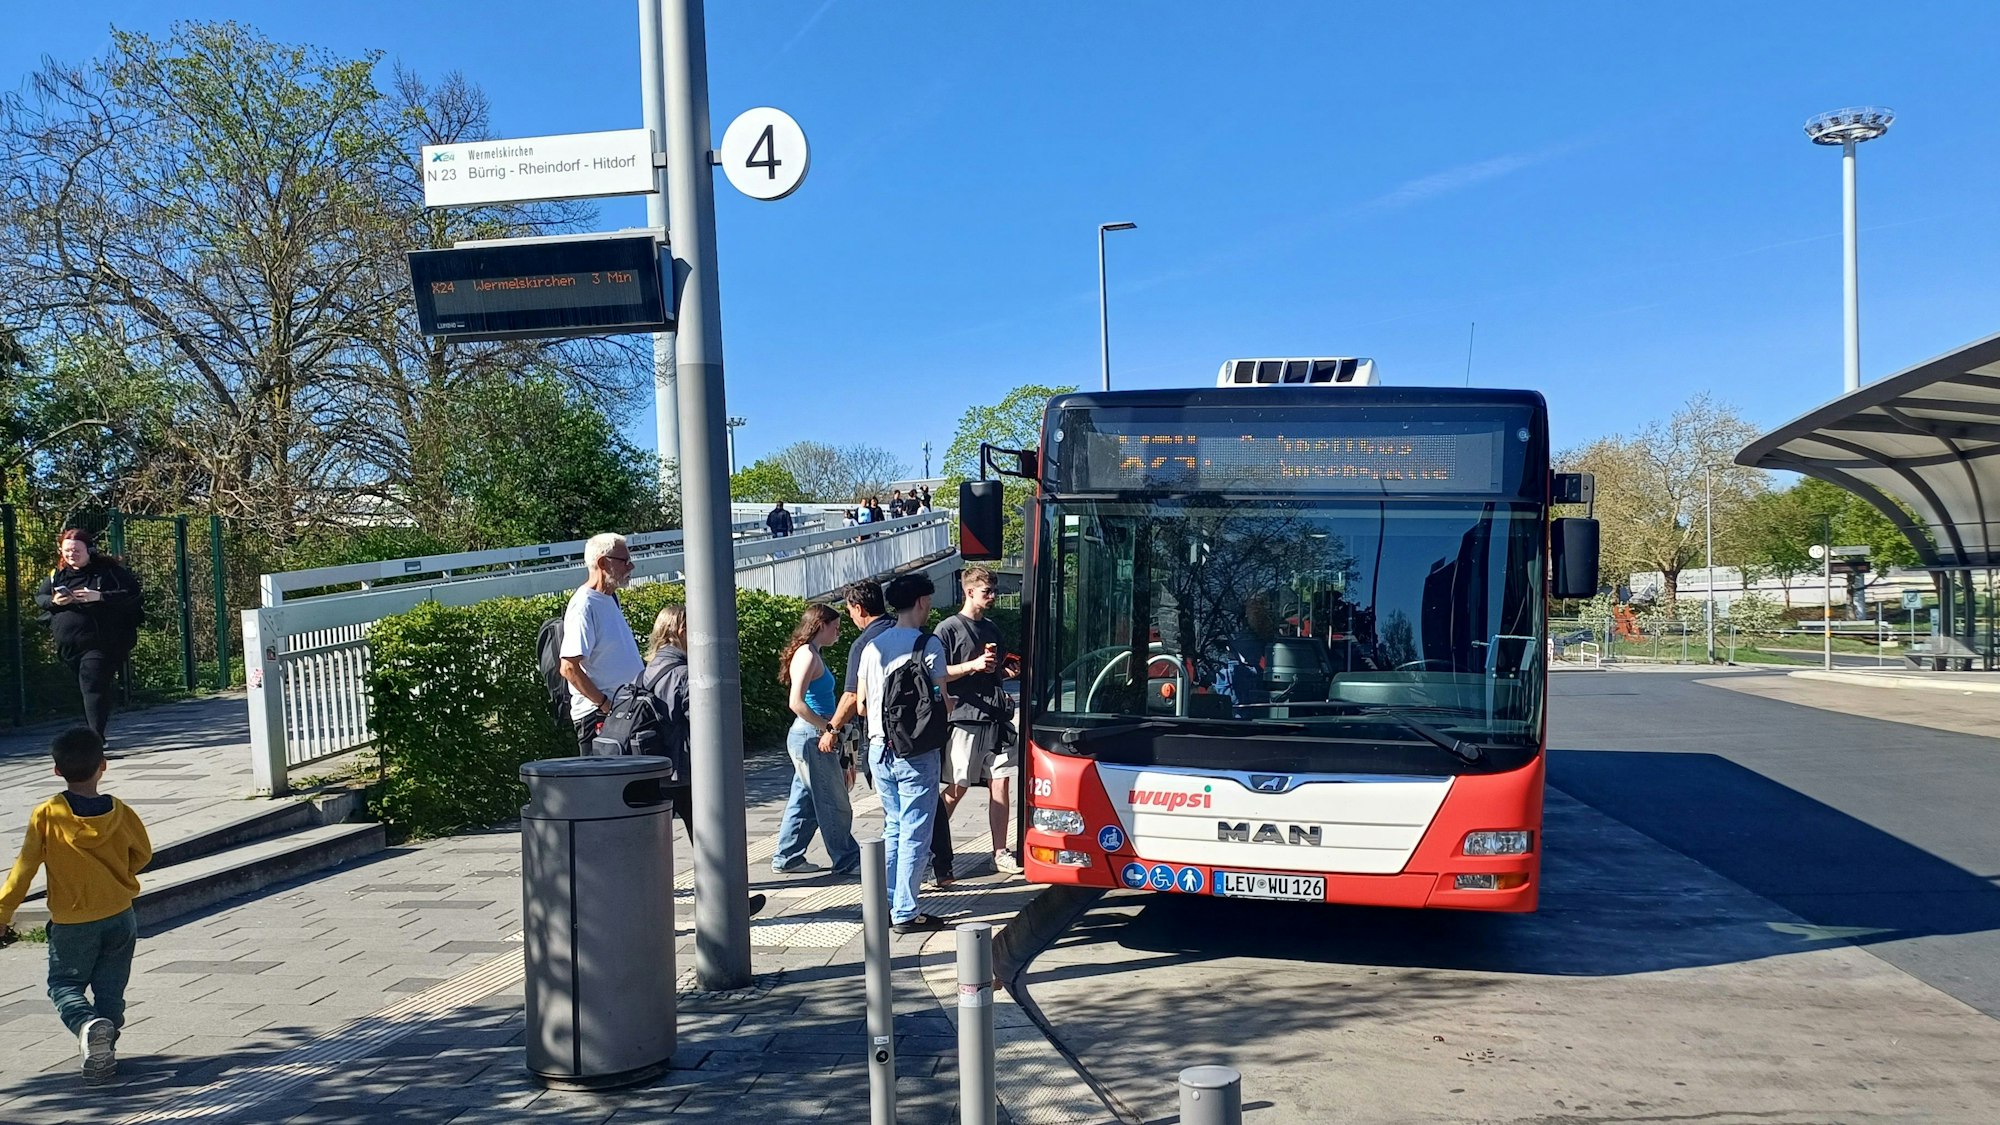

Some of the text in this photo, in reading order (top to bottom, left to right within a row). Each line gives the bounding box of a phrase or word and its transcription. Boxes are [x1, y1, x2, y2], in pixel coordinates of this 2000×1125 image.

[468, 146, 534, 161] Wermelskirchen
[745, 124, 782, 180] 4
[428, 170, 437, 181] N
[441, 168, 457, 180] 23
[468, 165, 506, 179] Bürrig
[519, 158, 581, 175] Rheindorf
[593, 154, 636, 170] Hitdorf
[431, 271, 632, 294] X24 Wermelskirchen 3 Min
[1028, 777, 1052, 797] 126
[1128, 785, 1211, 811] wupsi
[1217, 821, 1322, 846] MAN
[1225, 875, 1256, 892] LEV
[1268, 877, 1288, 894] WU
[1292, 879, 1322, 896] 126
